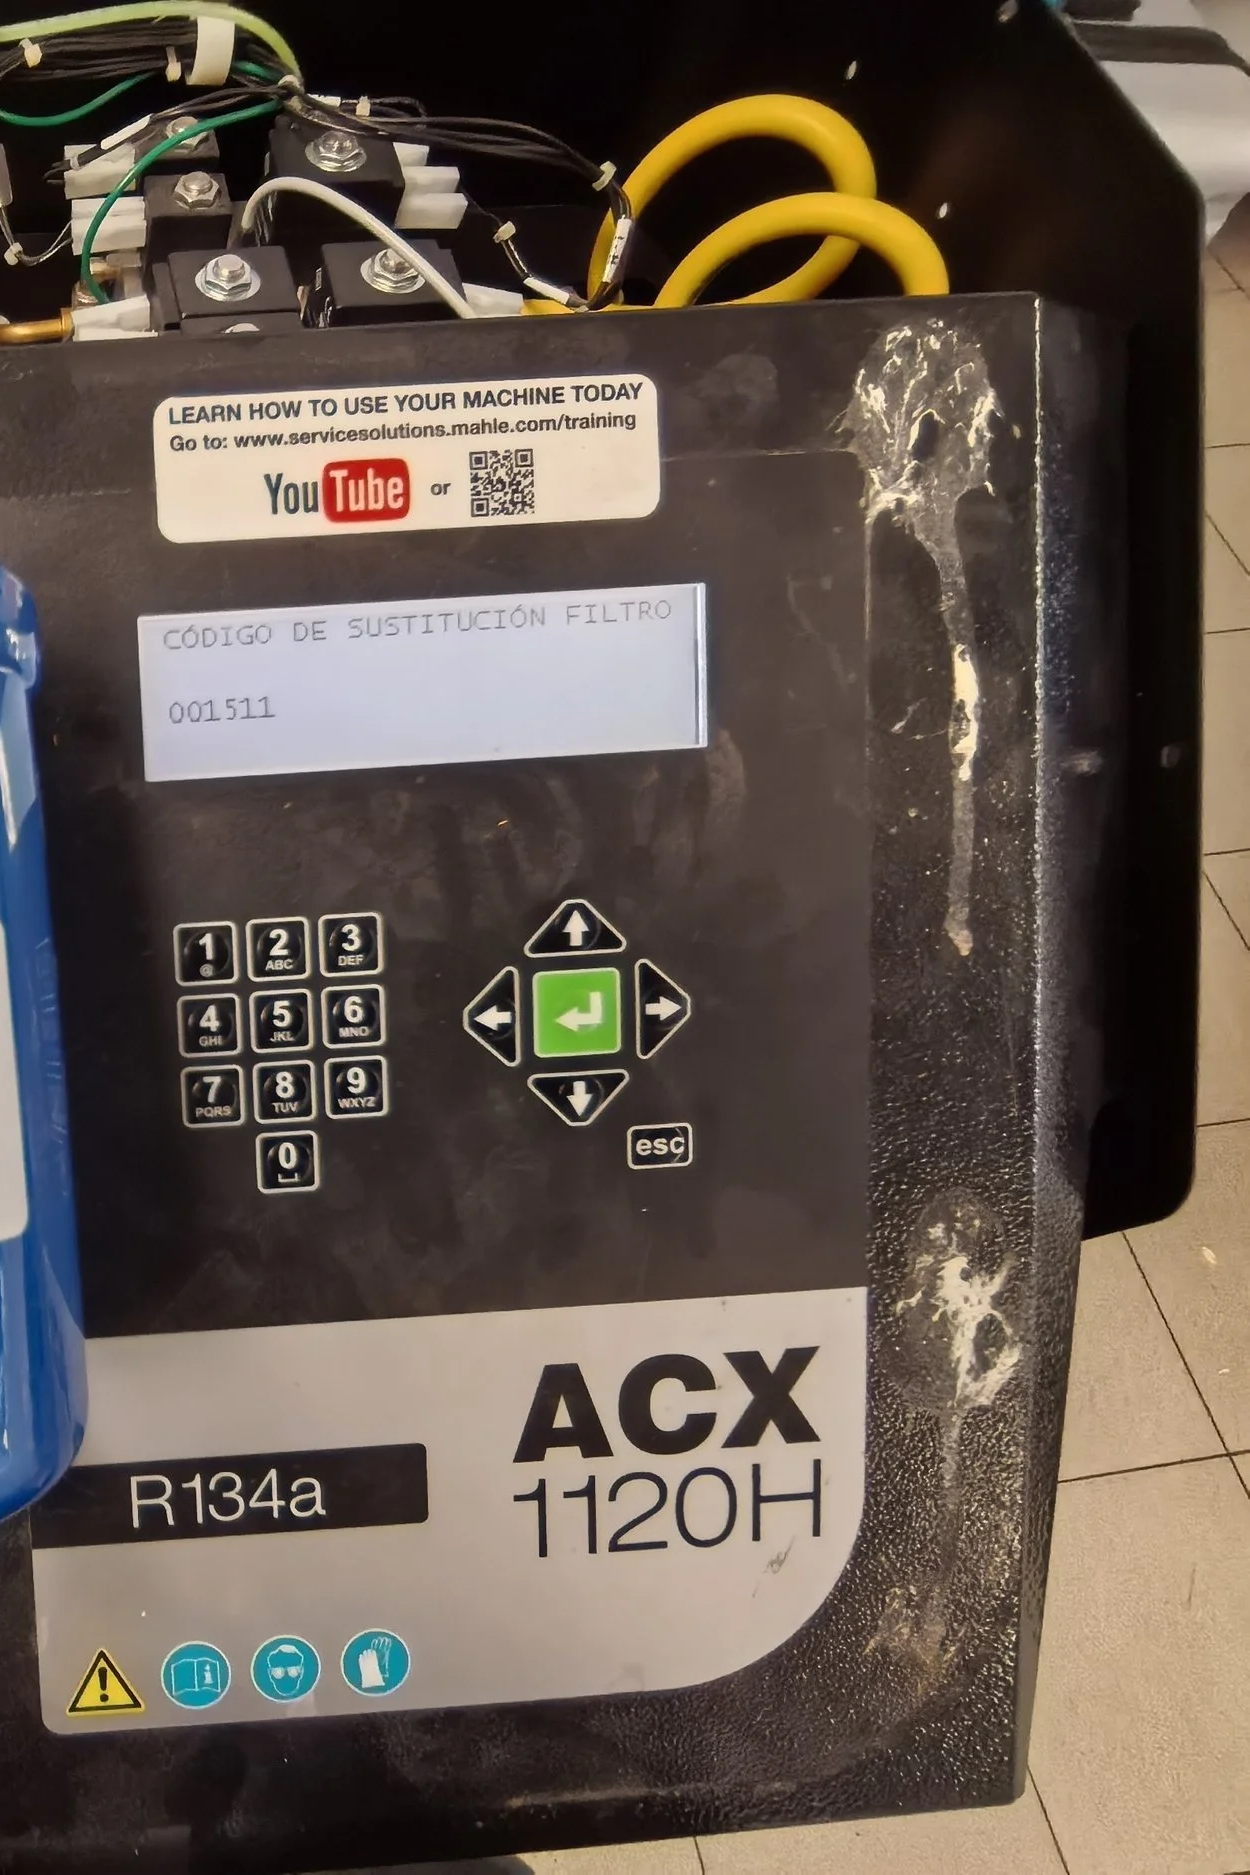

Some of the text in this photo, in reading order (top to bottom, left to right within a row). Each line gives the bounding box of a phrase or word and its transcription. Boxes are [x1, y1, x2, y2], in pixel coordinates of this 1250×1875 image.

[169, 382, 644, 424] LEARN HOW TO USE YOUR MACHINE TODAY
[170, 411, 636, 452] Go to: www.servicesolutions.mahle.com/training
[431, 481, 451, 497] or
[163, 599, 672, 650] CÓDIGO DE SUSTITUCIÓN FILTRO
[169, 696, 276, 724] 001511
[198, 933, 213, 961] 1
[269, 928, 290, 957] 2
[341, 924, 362, 952] 3
[265, 958, 295, 971] ABC
[338, 954, 364, 966] DEF
[199, 1004, 221, 1032] 4
[272, 1000, 292, 1028] 5
[344, 995, 364, 1024] 6
[270, 1031, 295, 1043] JKL
[203, 1076, 222, 1104] 7
[275, 1071, 295, 1099] 8
[347, 1066, 367, 1094] 9
[195, 1106, 232, 1118] PQRS
[272, 1101, 300, 1114] TUV
[337, 1096, 376, 1109] WXYZ
[278, 1142, 297, 1170] 0
[635, 1136, 686, 1157] esc
[512, 1346, 822, 1464] ACX
[129, 1467, 327, 1530] R134a
[512, 1459, 823, 1558] 1120H
